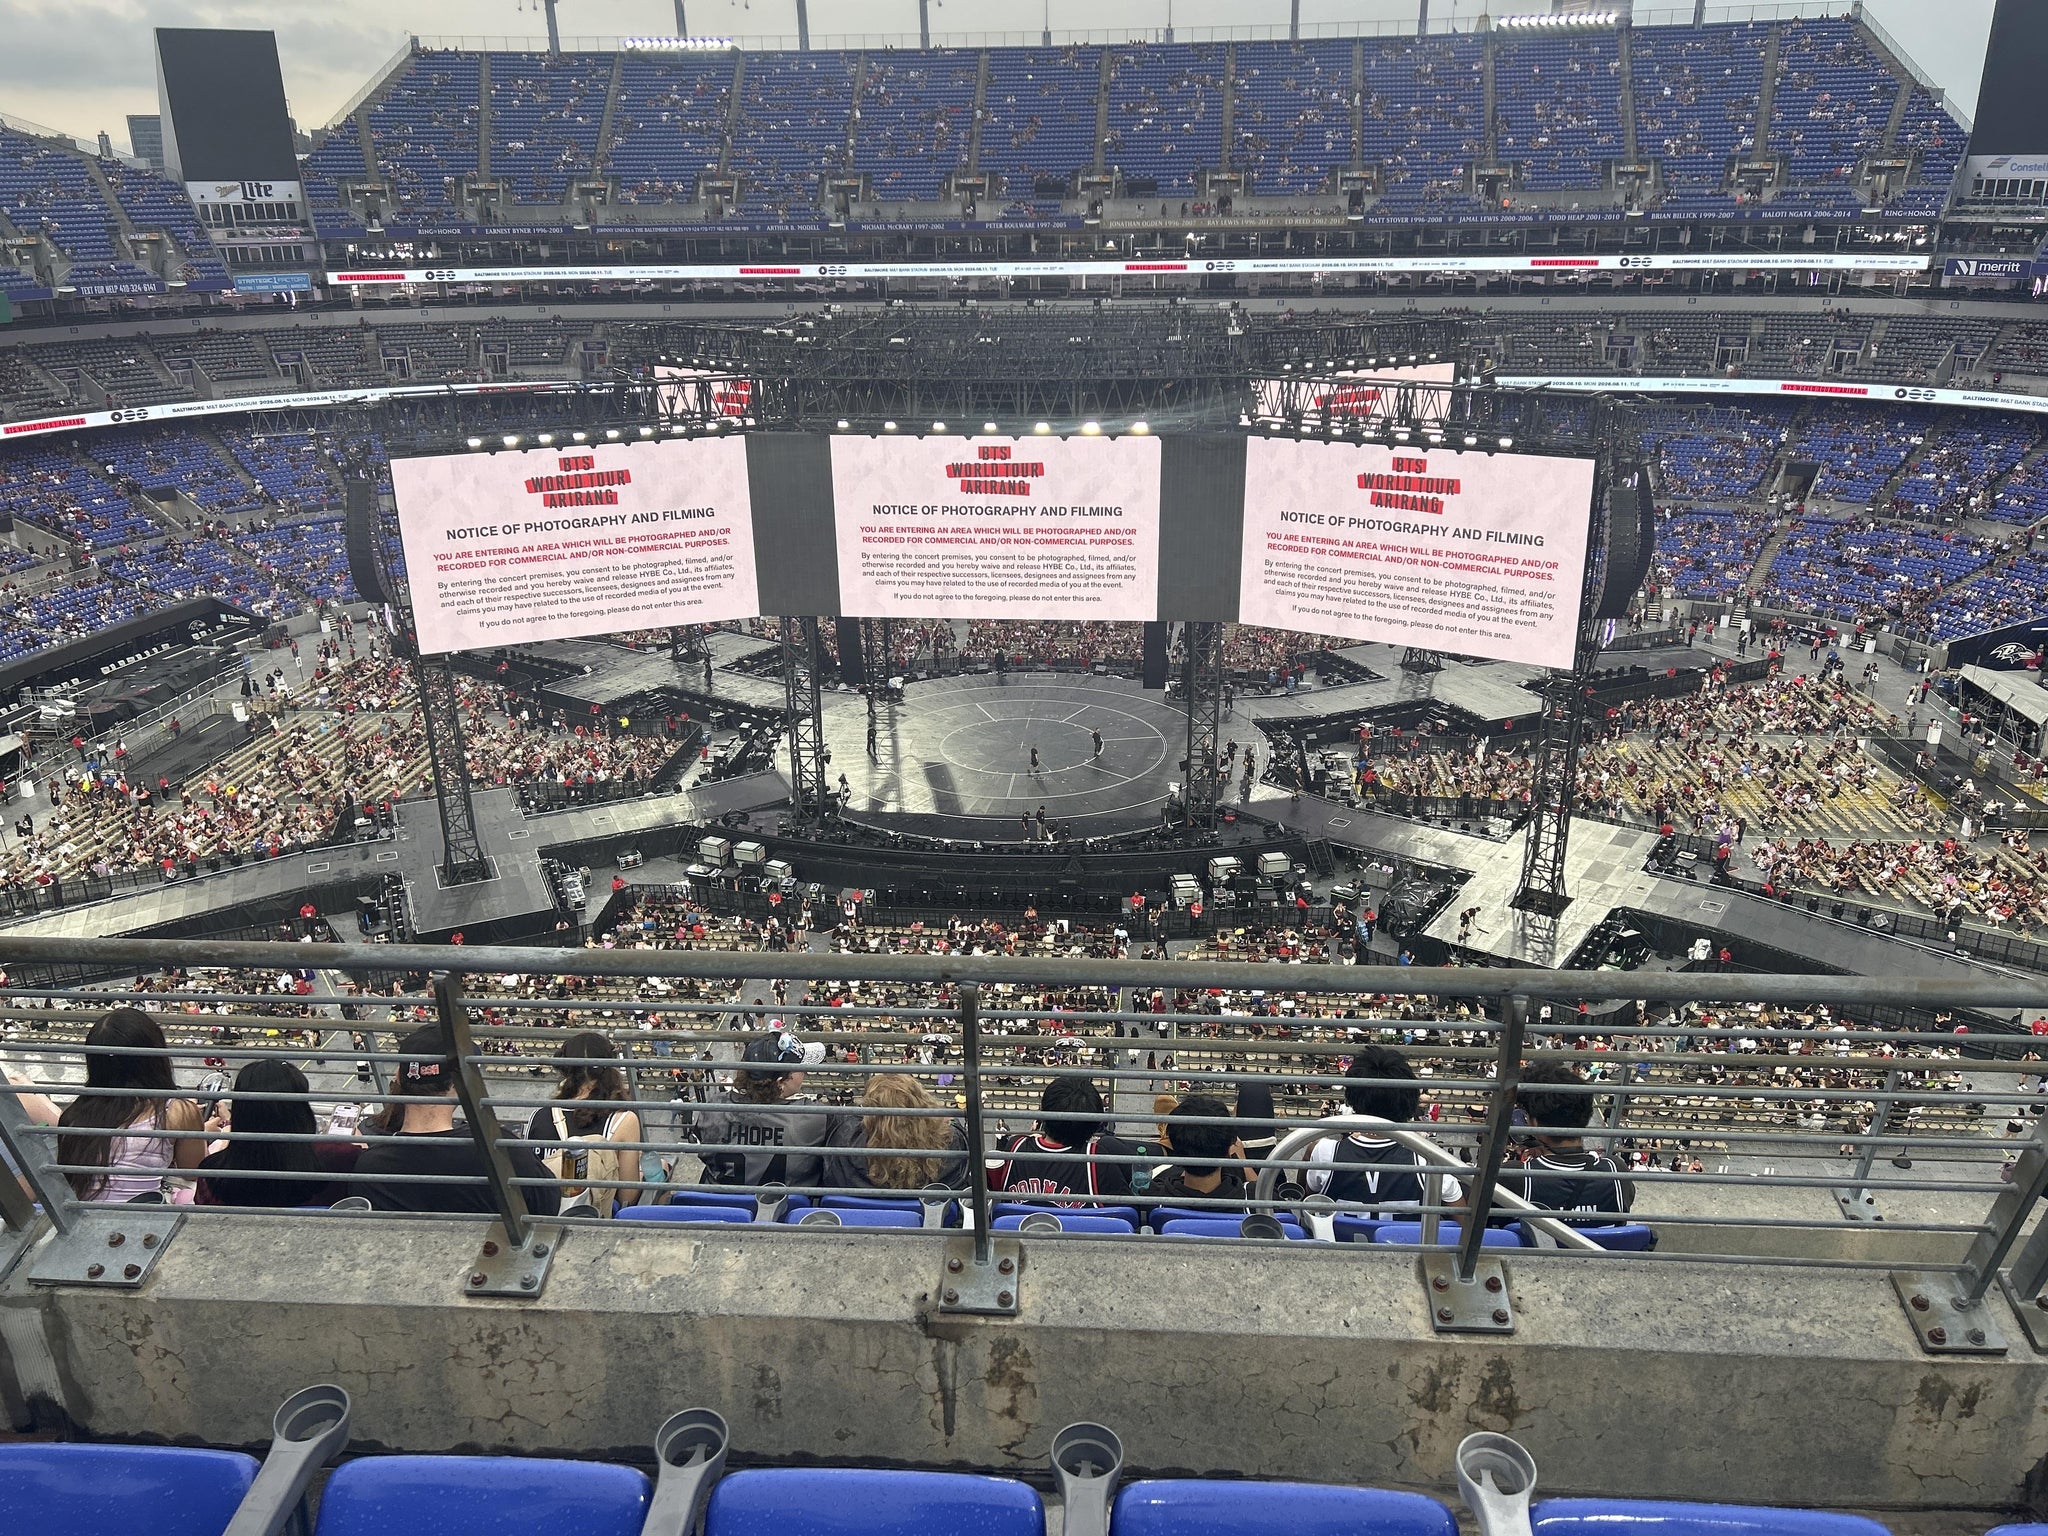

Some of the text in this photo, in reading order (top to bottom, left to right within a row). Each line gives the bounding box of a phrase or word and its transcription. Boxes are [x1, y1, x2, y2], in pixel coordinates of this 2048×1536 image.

[238, 182, 273, 201] Lite
[1978, 261, 2021, 273] merritt
[80, 286, 94, 295] TEXT
[94, 285, 105, 294] FOR
[105, 285, 118, 294] HELP
[981, 446, 1008, 461] BTS
[562, 456, 592, 472] BTS
[951, 462, 1039, 478] WORLD TOUR
[1395, 457, 1424, 474] BTS
[530, 470, 626, 493] WORLD TOUR
[964, 479, 1027, 495] ARIRANG
[1362, 471, 1455, 496] WORLD TOUR
[546, 488, 615, 510] ARIRANG
[1374, 492, 1440, 514] ARIRANG
[872, 504, 1123, 517] NOTICE OF PHOTOGRAPHY AND FILMING
[446, 506, 715, 541] NOTICE OF PHOTOGRAPHY AND FILMING
[859, 525, 877, 533] YOU
[895, 526, 936, 534] ENTERING
[973, 527, 1001, 535] WHICH
[1002, 527, 1021, 535] WILL
[1023, 527, 1034, 535] BE
[1035, 527, 1102, 536] PHOTOGRAPHED
[1103, 528, 1137, 536] AND/OR
[1280, 510, 1545, 547] NOTICE OF PHOTOGRAPHY AND FILMING
[433, 527, 731, 562] YOU ARE ENTERING AN AREA WHICH WILL BE PHOTOGRAPHED AND/OR
[862, 536, 1134, 546] RECORDED FOR COMMERCIAL AND/OR NON-COMMERCIAL PURPOSES.
[1267, 542, 1555, 581] RECORDED FOR COMMERCIAL AND/OR NON-COMMERCIAL PURPOSES.
[1275, 560, 1302, 572] entering
[1316, 565, 1342, 575] concert
[1343, 568, 1377, 580] premises,
[1393, 574, 1422, 584] consent
[1444, 579, 1499, 594] photographed,
[1500, 585, 1527, 597] filmed,
[1528, 588, 1556, 601] and/or
[525, 615, 547, 624] agree
[569, 607, 606, 620] foregoing,
[606, 605, 630, 616] please
[653, 600, 672, 609] enter
[673, 599, 686, 607] this
[1366, 1170, 1380, 1194] V
